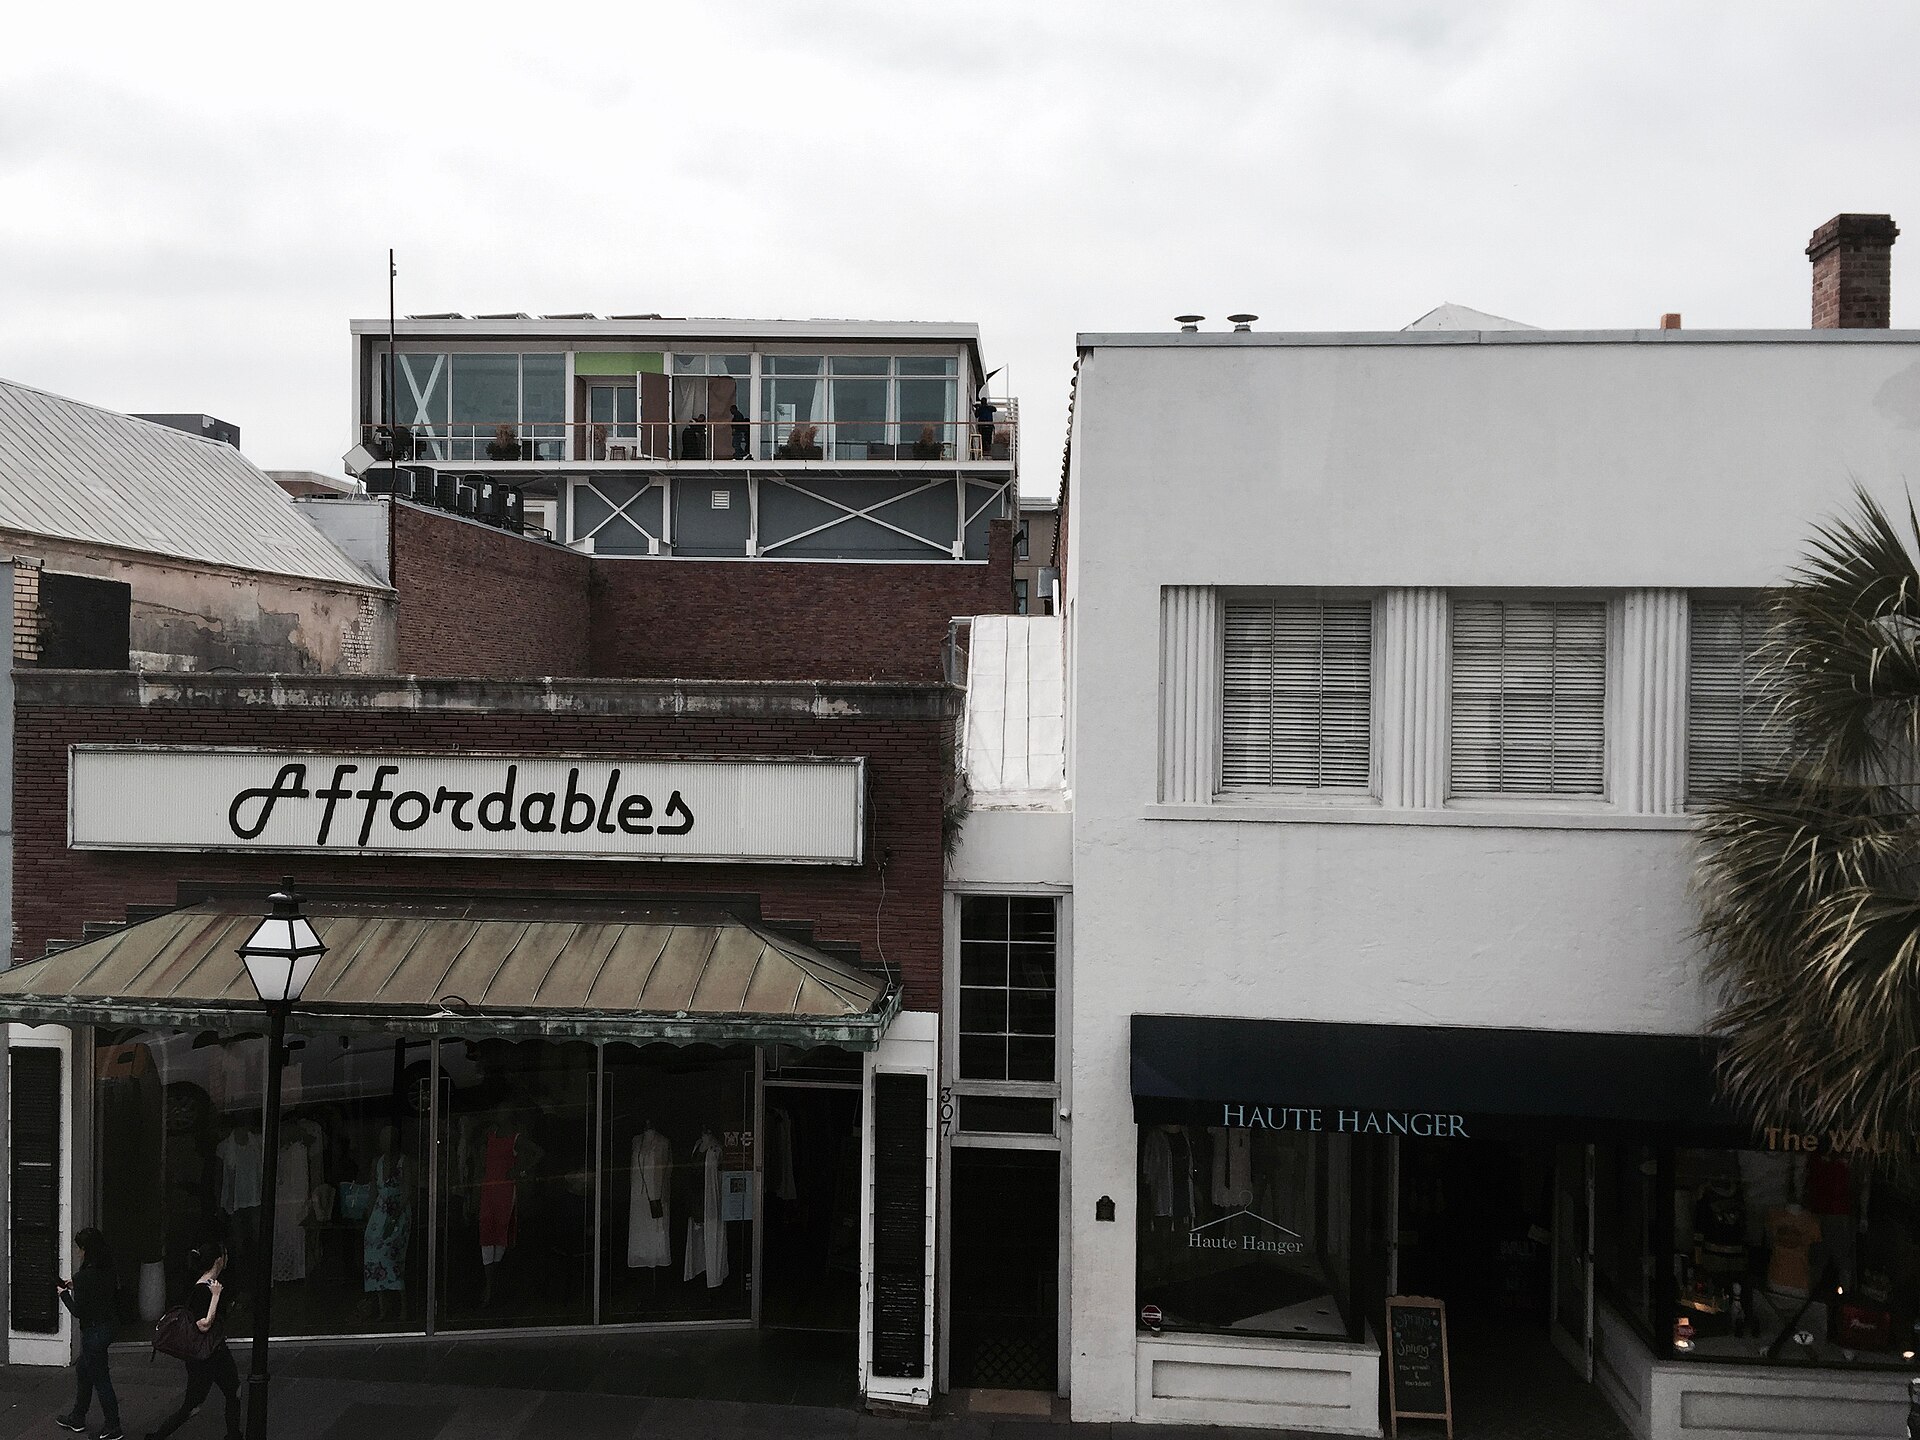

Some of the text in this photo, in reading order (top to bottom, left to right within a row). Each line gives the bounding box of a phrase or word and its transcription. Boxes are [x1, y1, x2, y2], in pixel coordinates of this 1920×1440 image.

[229, 764, 694, 846] Affordables
[941, 1087, 953, 1136] 307
[1223, 1103, 1471, 1139] HAUTE HANGER
[1764, 1127, 1819, 1151] The
[1188, 1232, 1304, 1256] Haute Hanger
